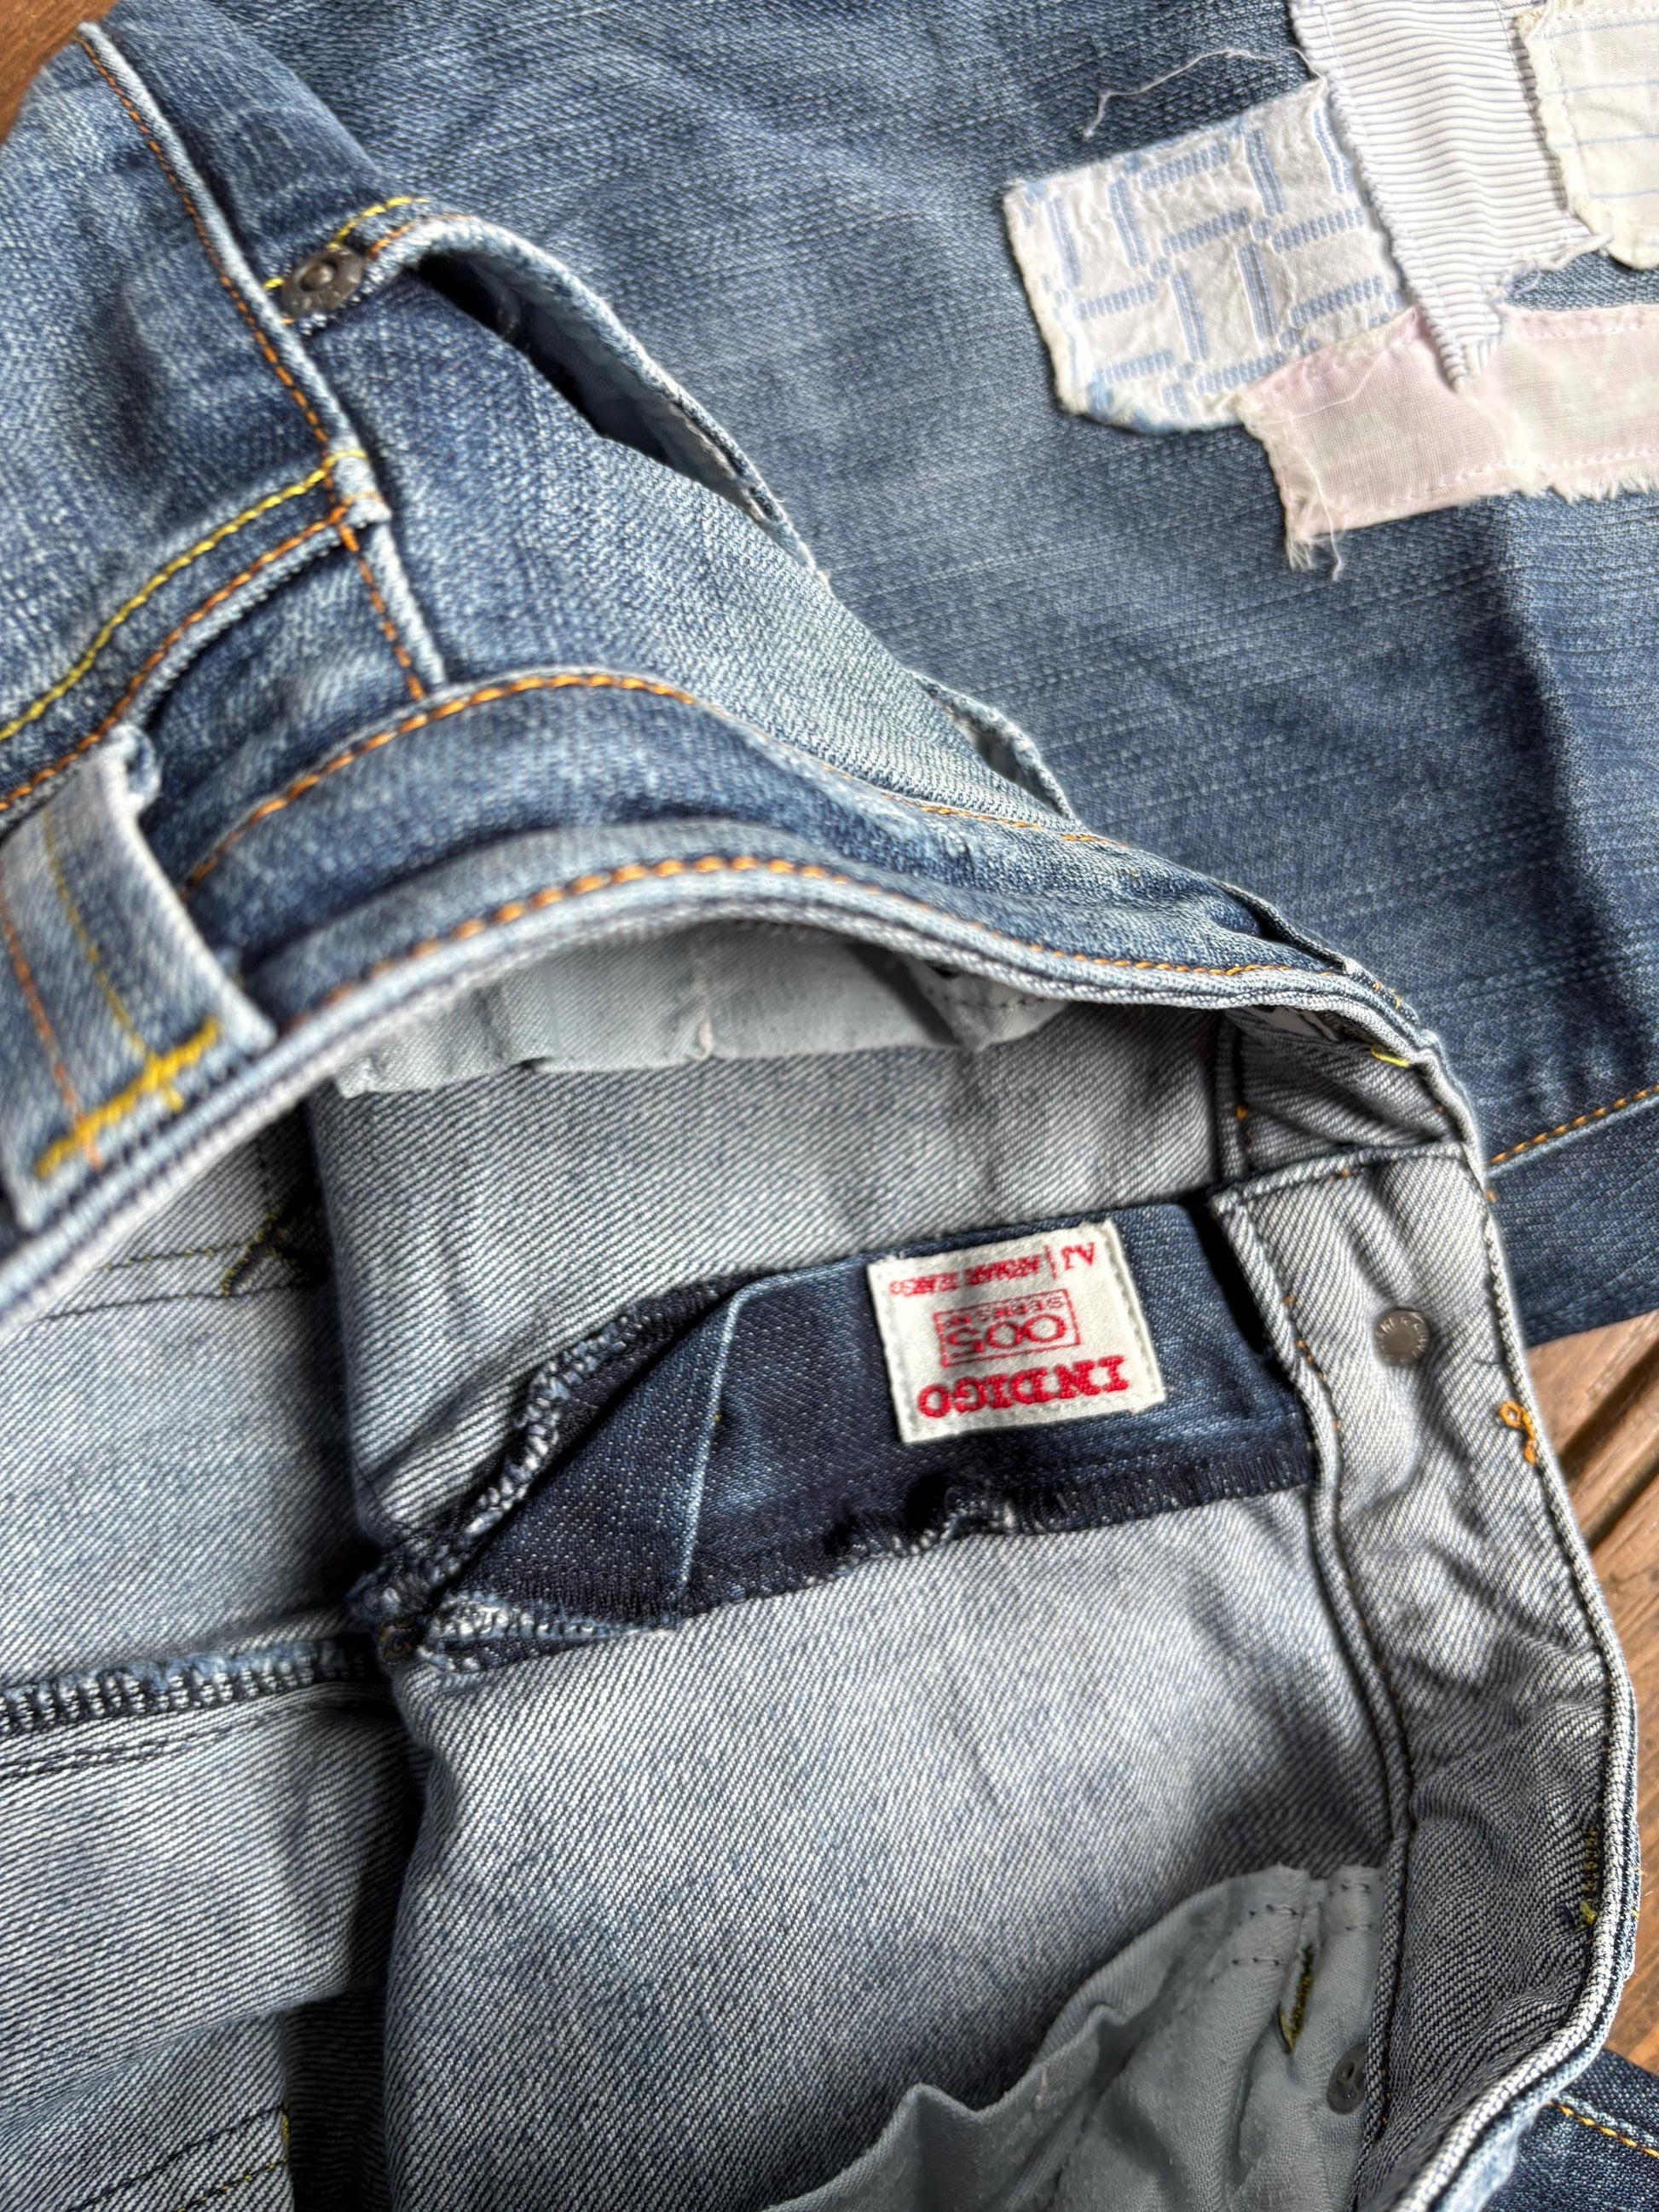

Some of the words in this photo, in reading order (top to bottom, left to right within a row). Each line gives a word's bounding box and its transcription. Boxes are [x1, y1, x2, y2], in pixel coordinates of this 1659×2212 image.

[1061, 1242, 1095, 1270] AJ
[947, 1314, 1067, 1359] 005
[917, 1354, 1130, 1419] INDIGO
